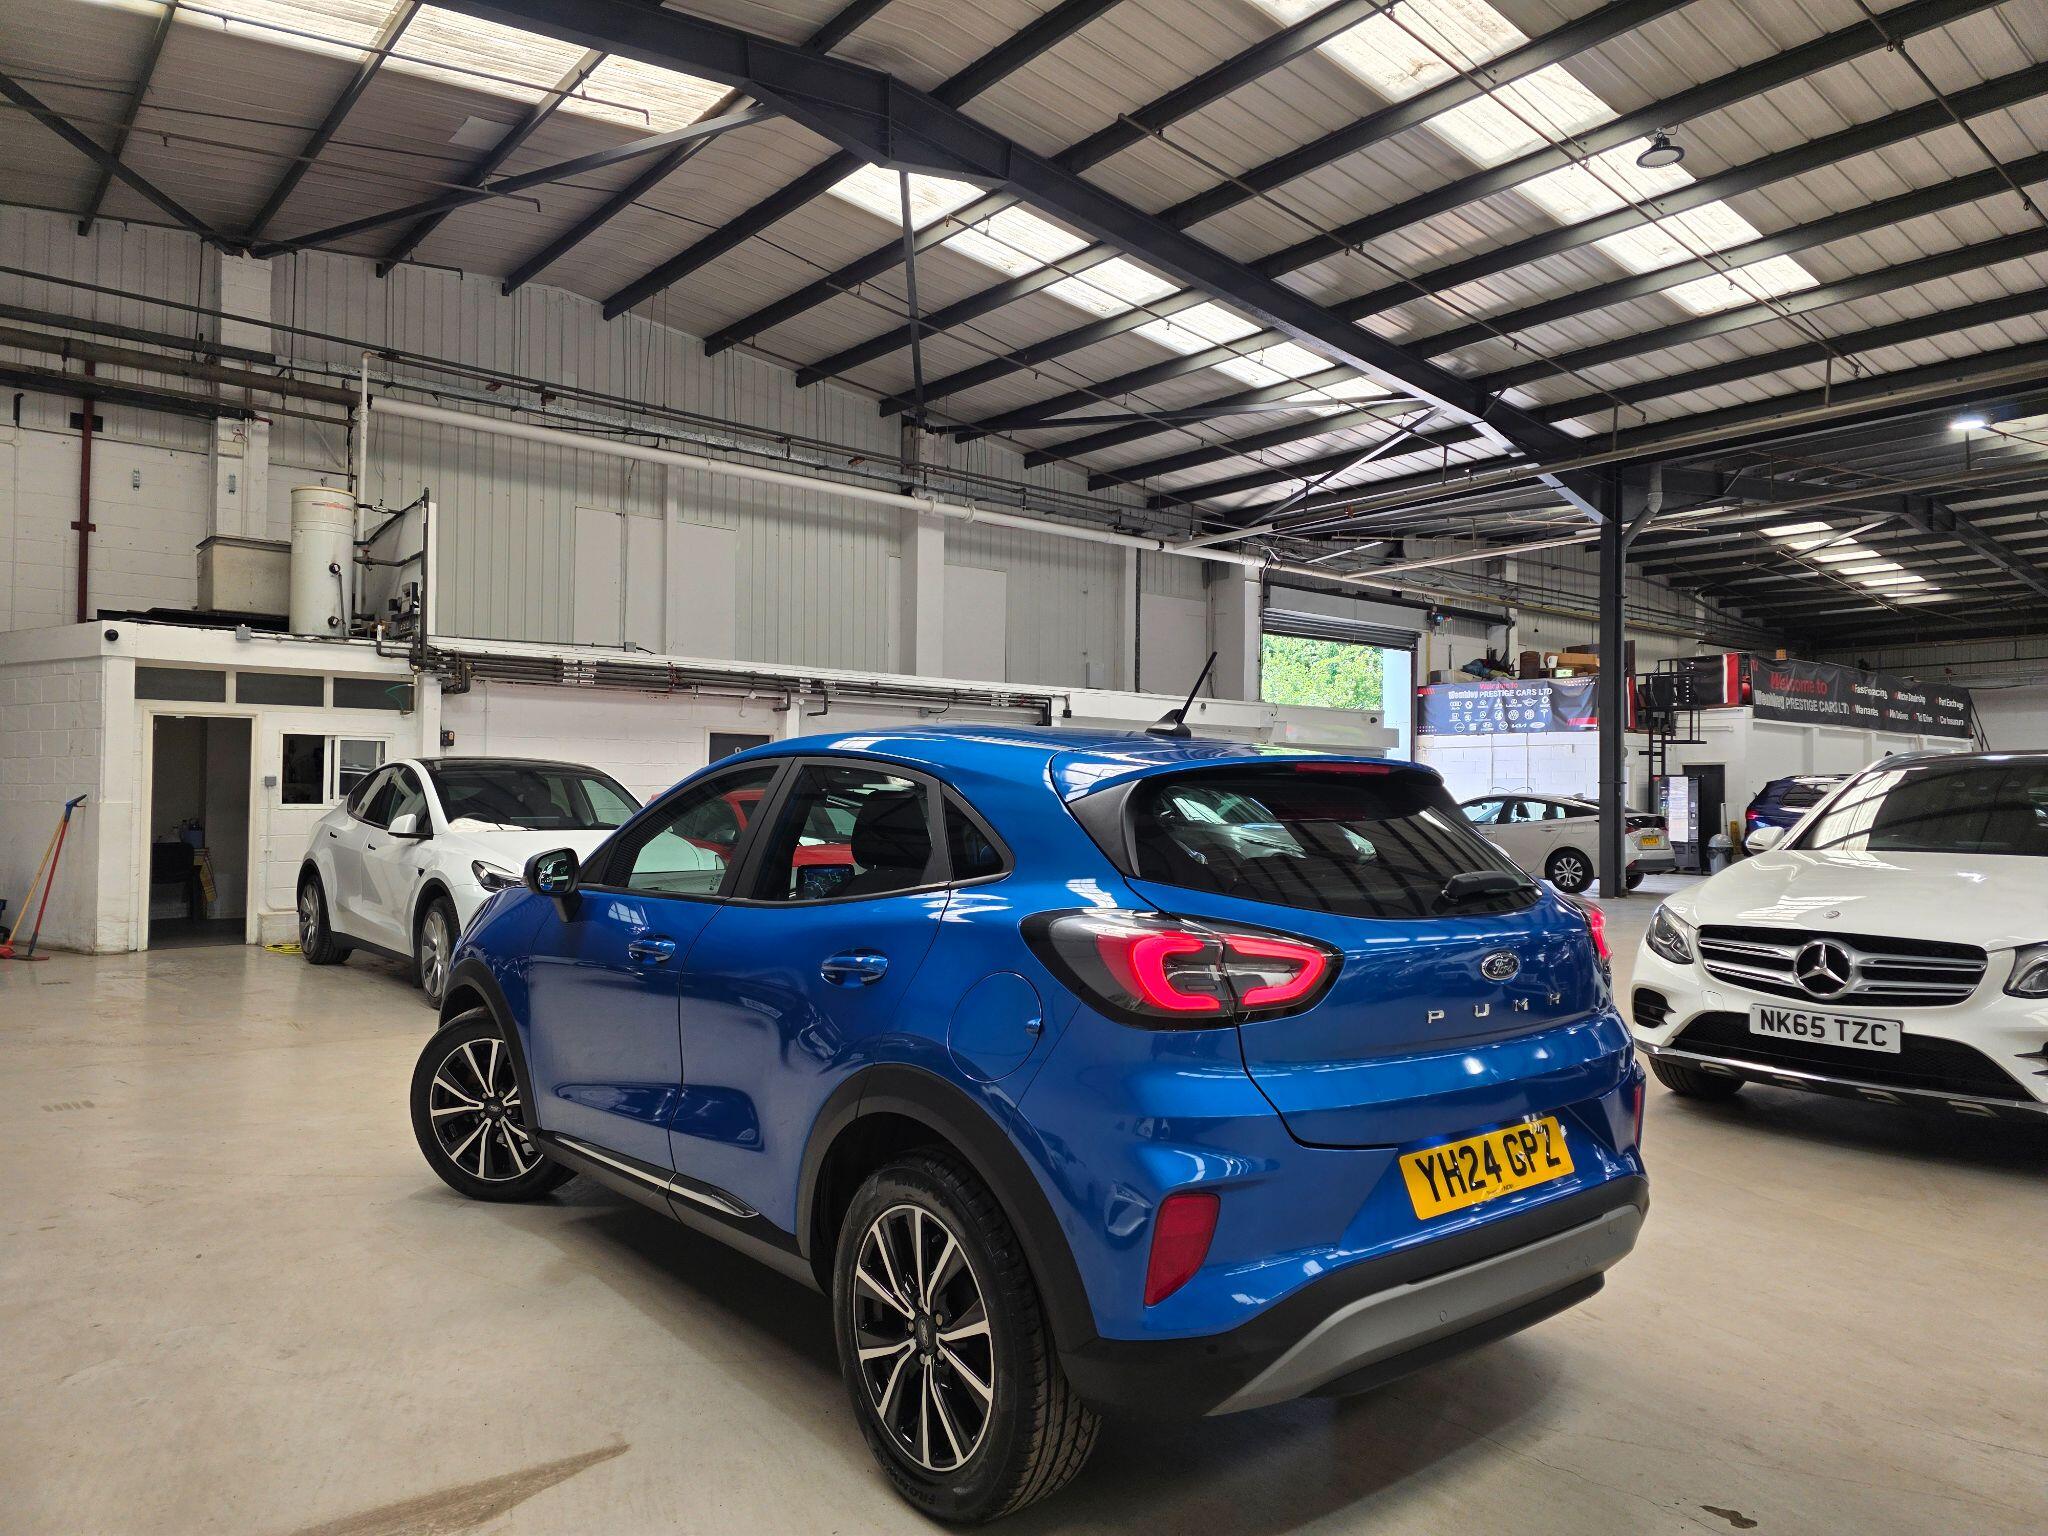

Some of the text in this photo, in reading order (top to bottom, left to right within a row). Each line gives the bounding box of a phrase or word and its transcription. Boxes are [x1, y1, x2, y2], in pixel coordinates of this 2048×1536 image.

[1479, 689, 1515, 698] PRESTIGE
[1516, 688, 1537, 697] CARS
[1538, 687, 1553, 695] LTD
[1769, 671, 1828, 695] Welcome to
[1785, 696, 1819, 712] PRESTIGE
[1493, 957, 1514, 975] Ford
[1760, 1008, 1887, 1047] NK65 TZC
[1414, 1123, 1562, 1203] YH24 GPZ
